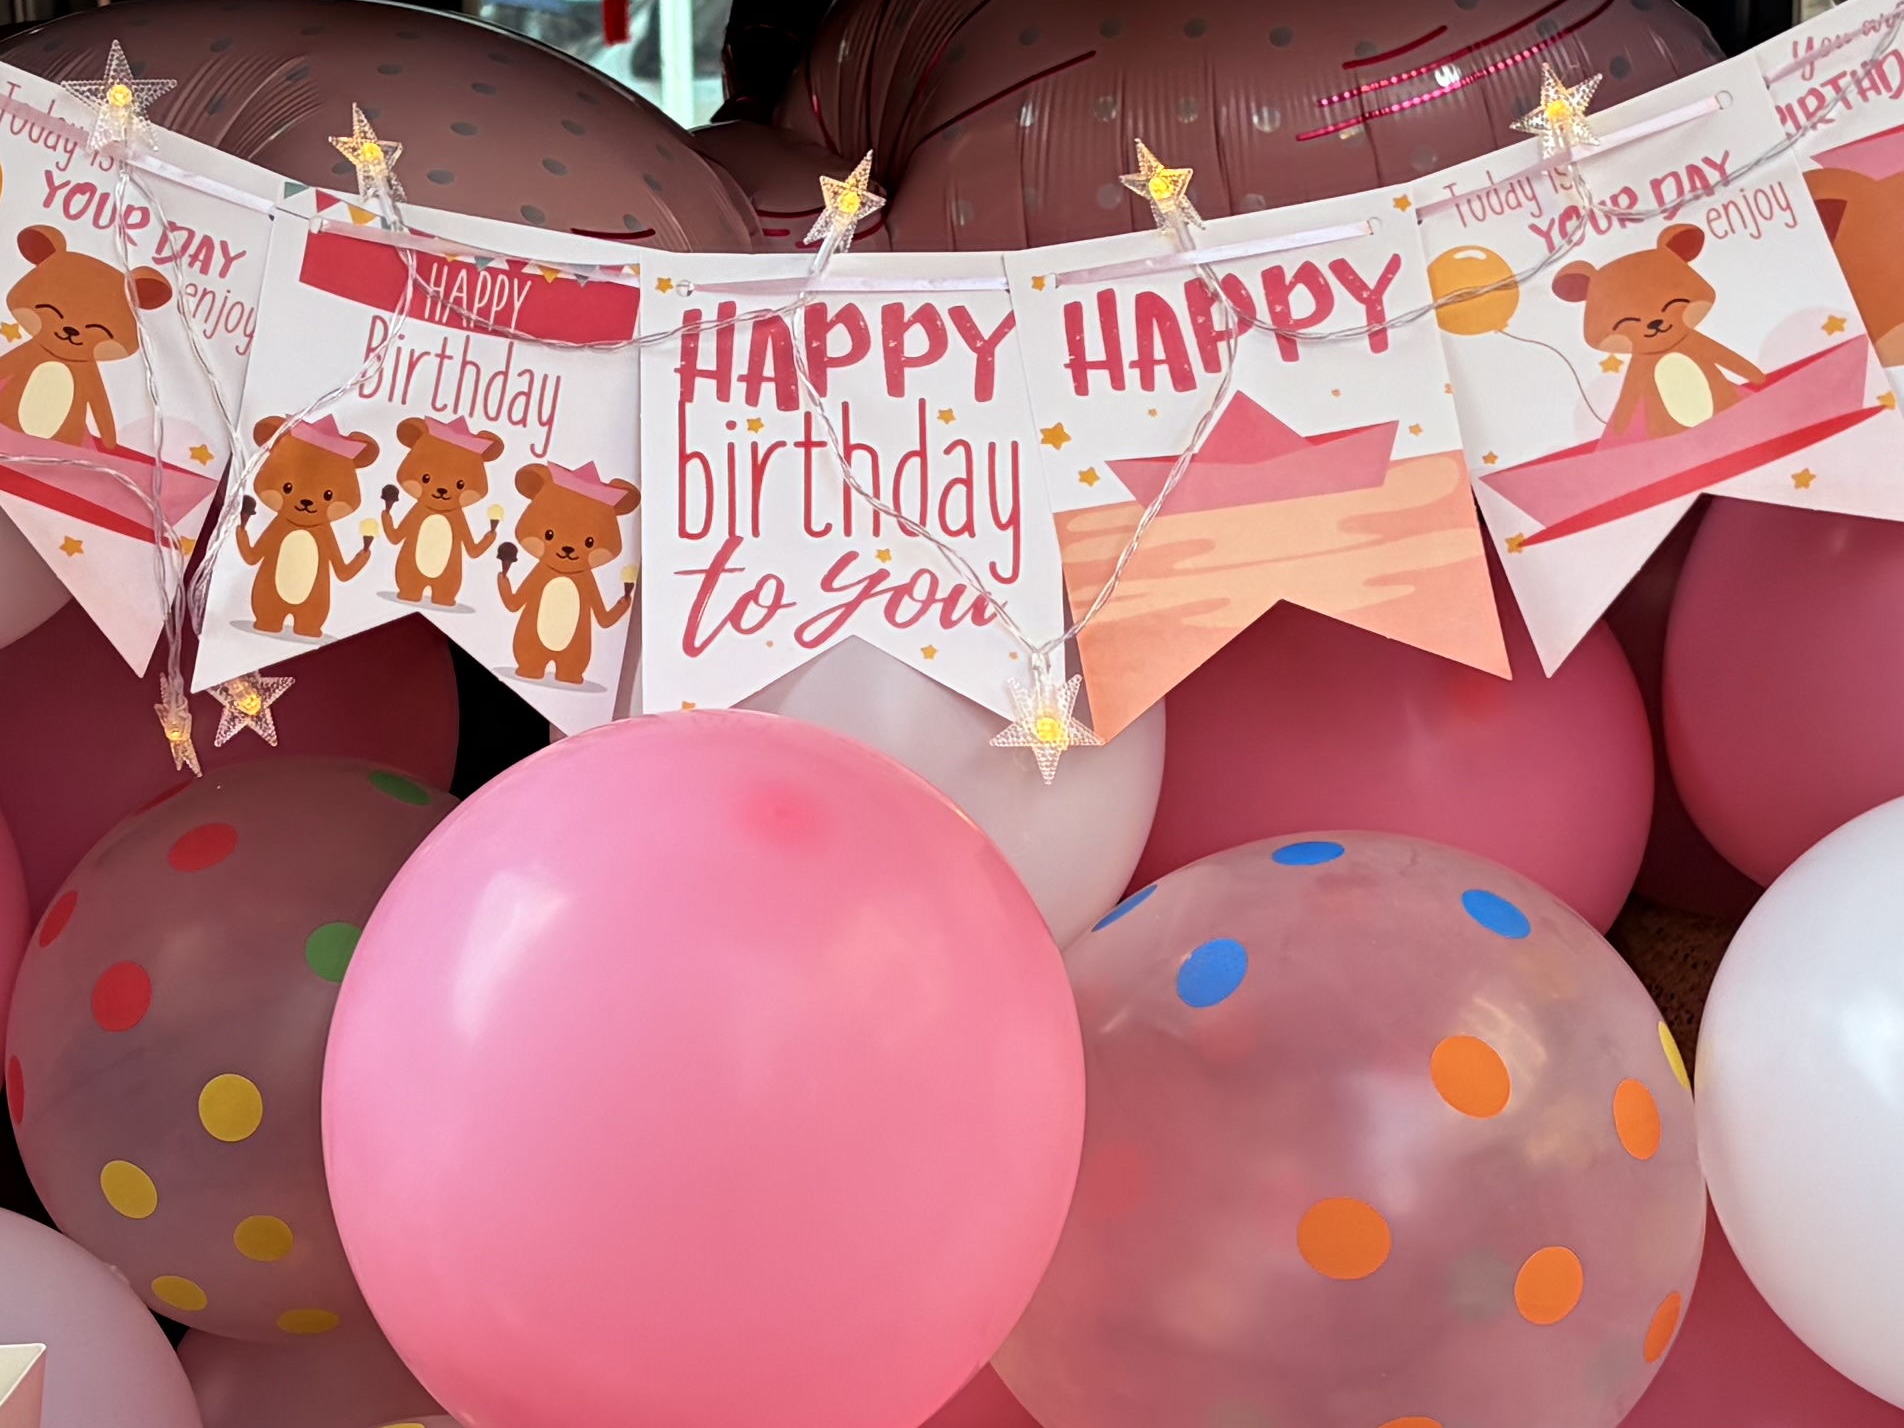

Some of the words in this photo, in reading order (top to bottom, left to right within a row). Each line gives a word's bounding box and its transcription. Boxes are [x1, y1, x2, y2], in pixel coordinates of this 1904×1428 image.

[42, 169, 151, 247] YOUR
[151, 221, 246, 279] DAY
[1527, 185, 1646, 255] YOUR
[1649, 150, 1730, 221] DAY
[1705, 180, 1798, 240] enjoy
[184, 282, 256, 356] enjoy
[424, 262, 532, 333] HAPPY
[1063, 253, 1402, 397] HAPPY
[358, 315, 561, 458] Birthday
[674, 300, 1017, 412] HAPPY
[678, 398, 1021, 584] birthday
[674, 535, 797, 658] to
[793, 550, 1008, 649] you
